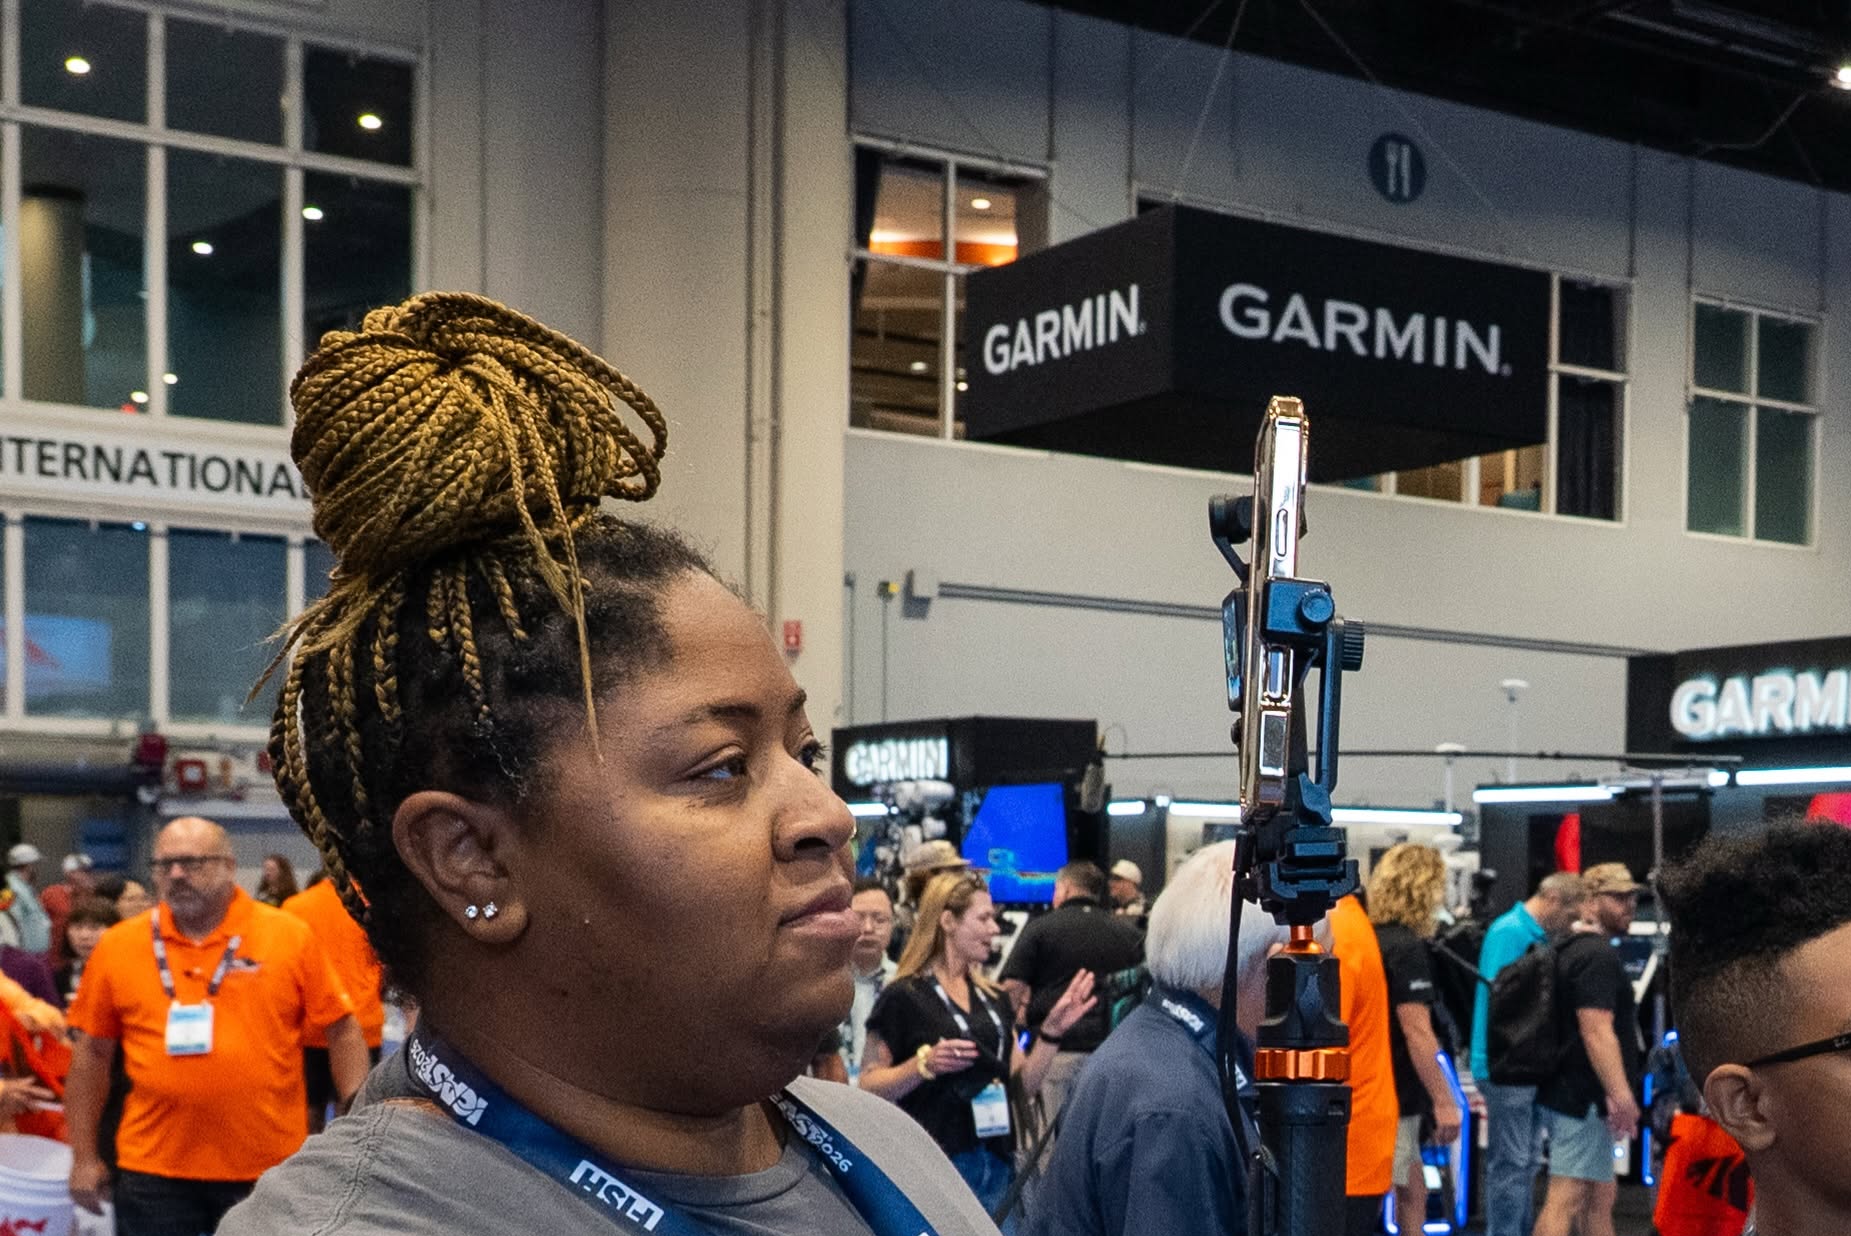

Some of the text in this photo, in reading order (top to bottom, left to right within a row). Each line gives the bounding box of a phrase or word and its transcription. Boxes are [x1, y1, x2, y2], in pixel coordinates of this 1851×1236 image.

[983, 283, 1141, 376] GARMIN
[1218, 282, 1502, 377] GARMIN
[0, 437, 312, 499] TERNATIONA
[845, 736, 949, 787] GARMIN
[809, 1129, 854, 1174] 2026
